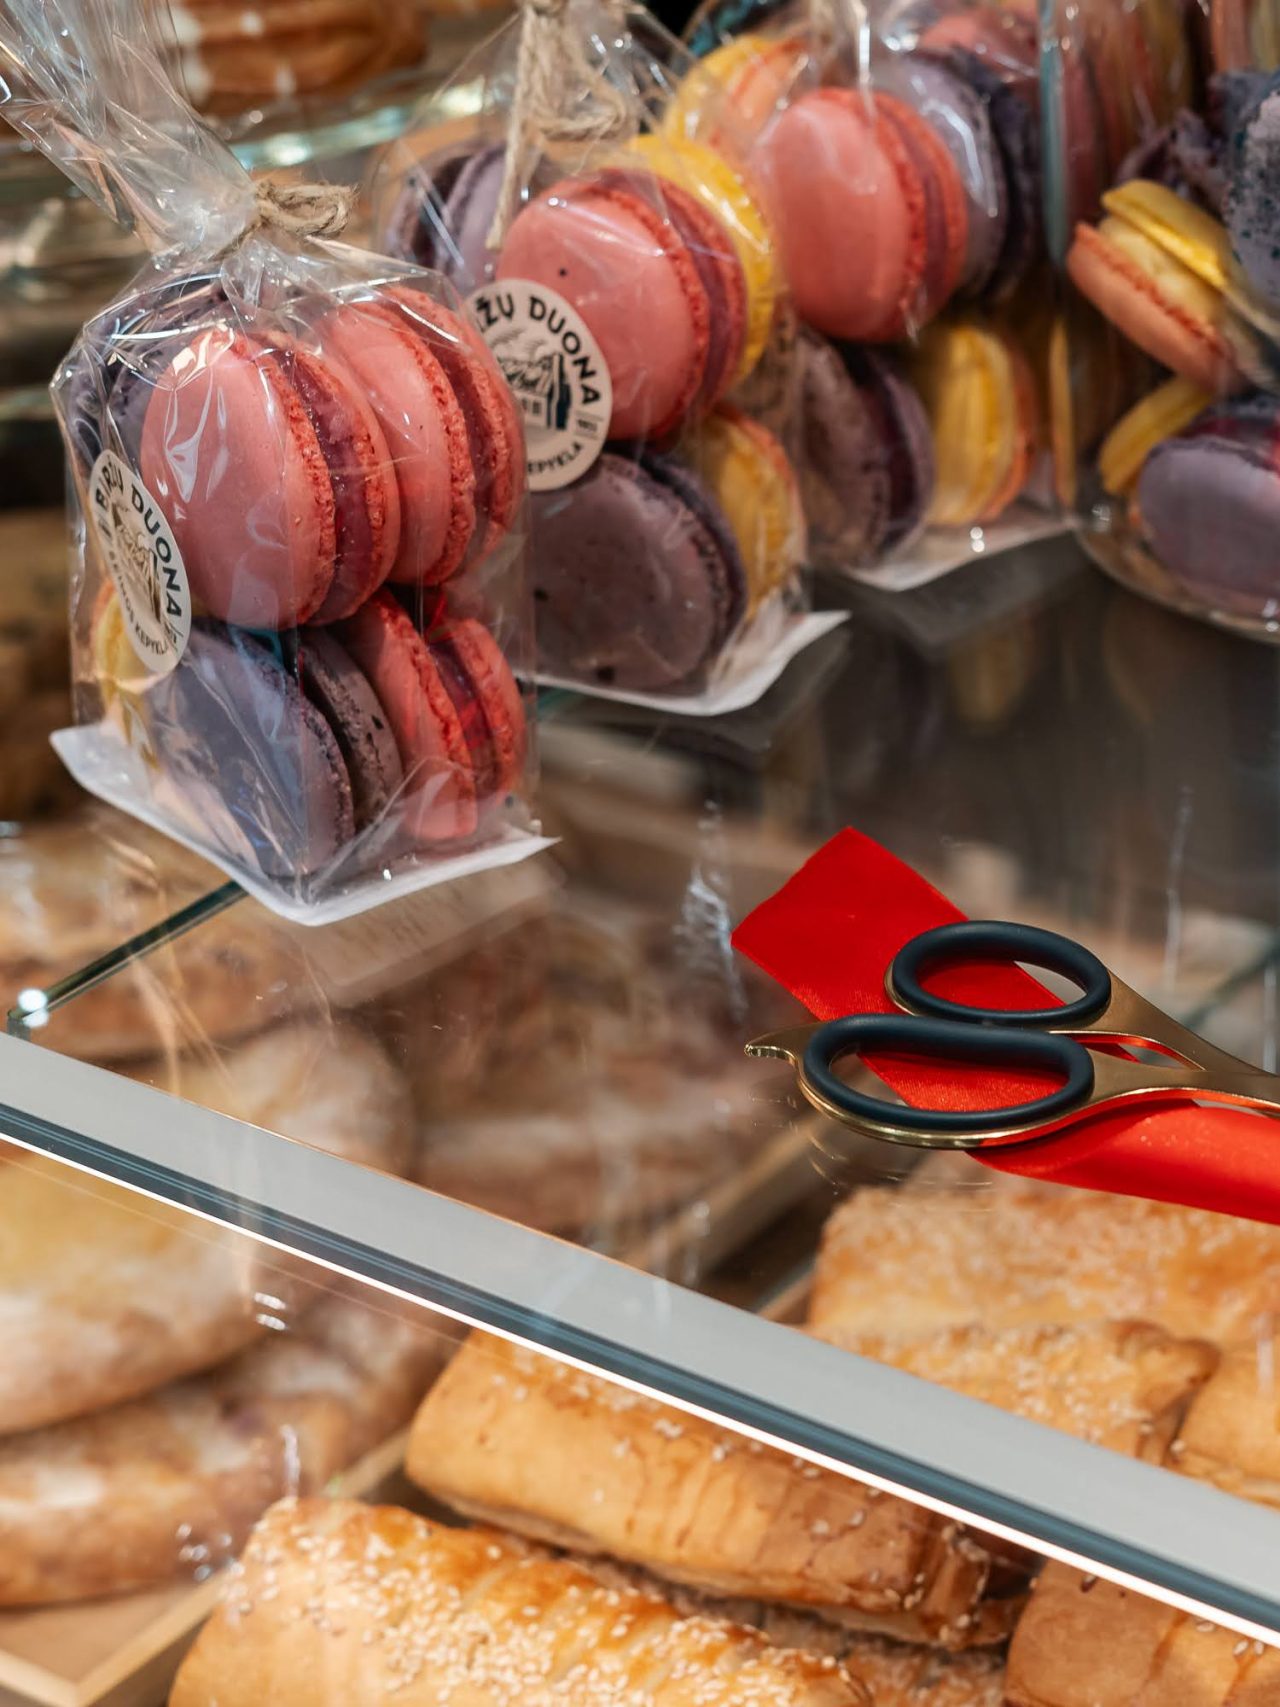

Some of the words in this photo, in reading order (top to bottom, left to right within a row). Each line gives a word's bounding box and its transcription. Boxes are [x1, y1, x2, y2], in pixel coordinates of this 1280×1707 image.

[529, 296, 601, 404] DUONA
[526, 441, 583, 476] EPYKLA
[131, 484, 183, 617] DUONA
